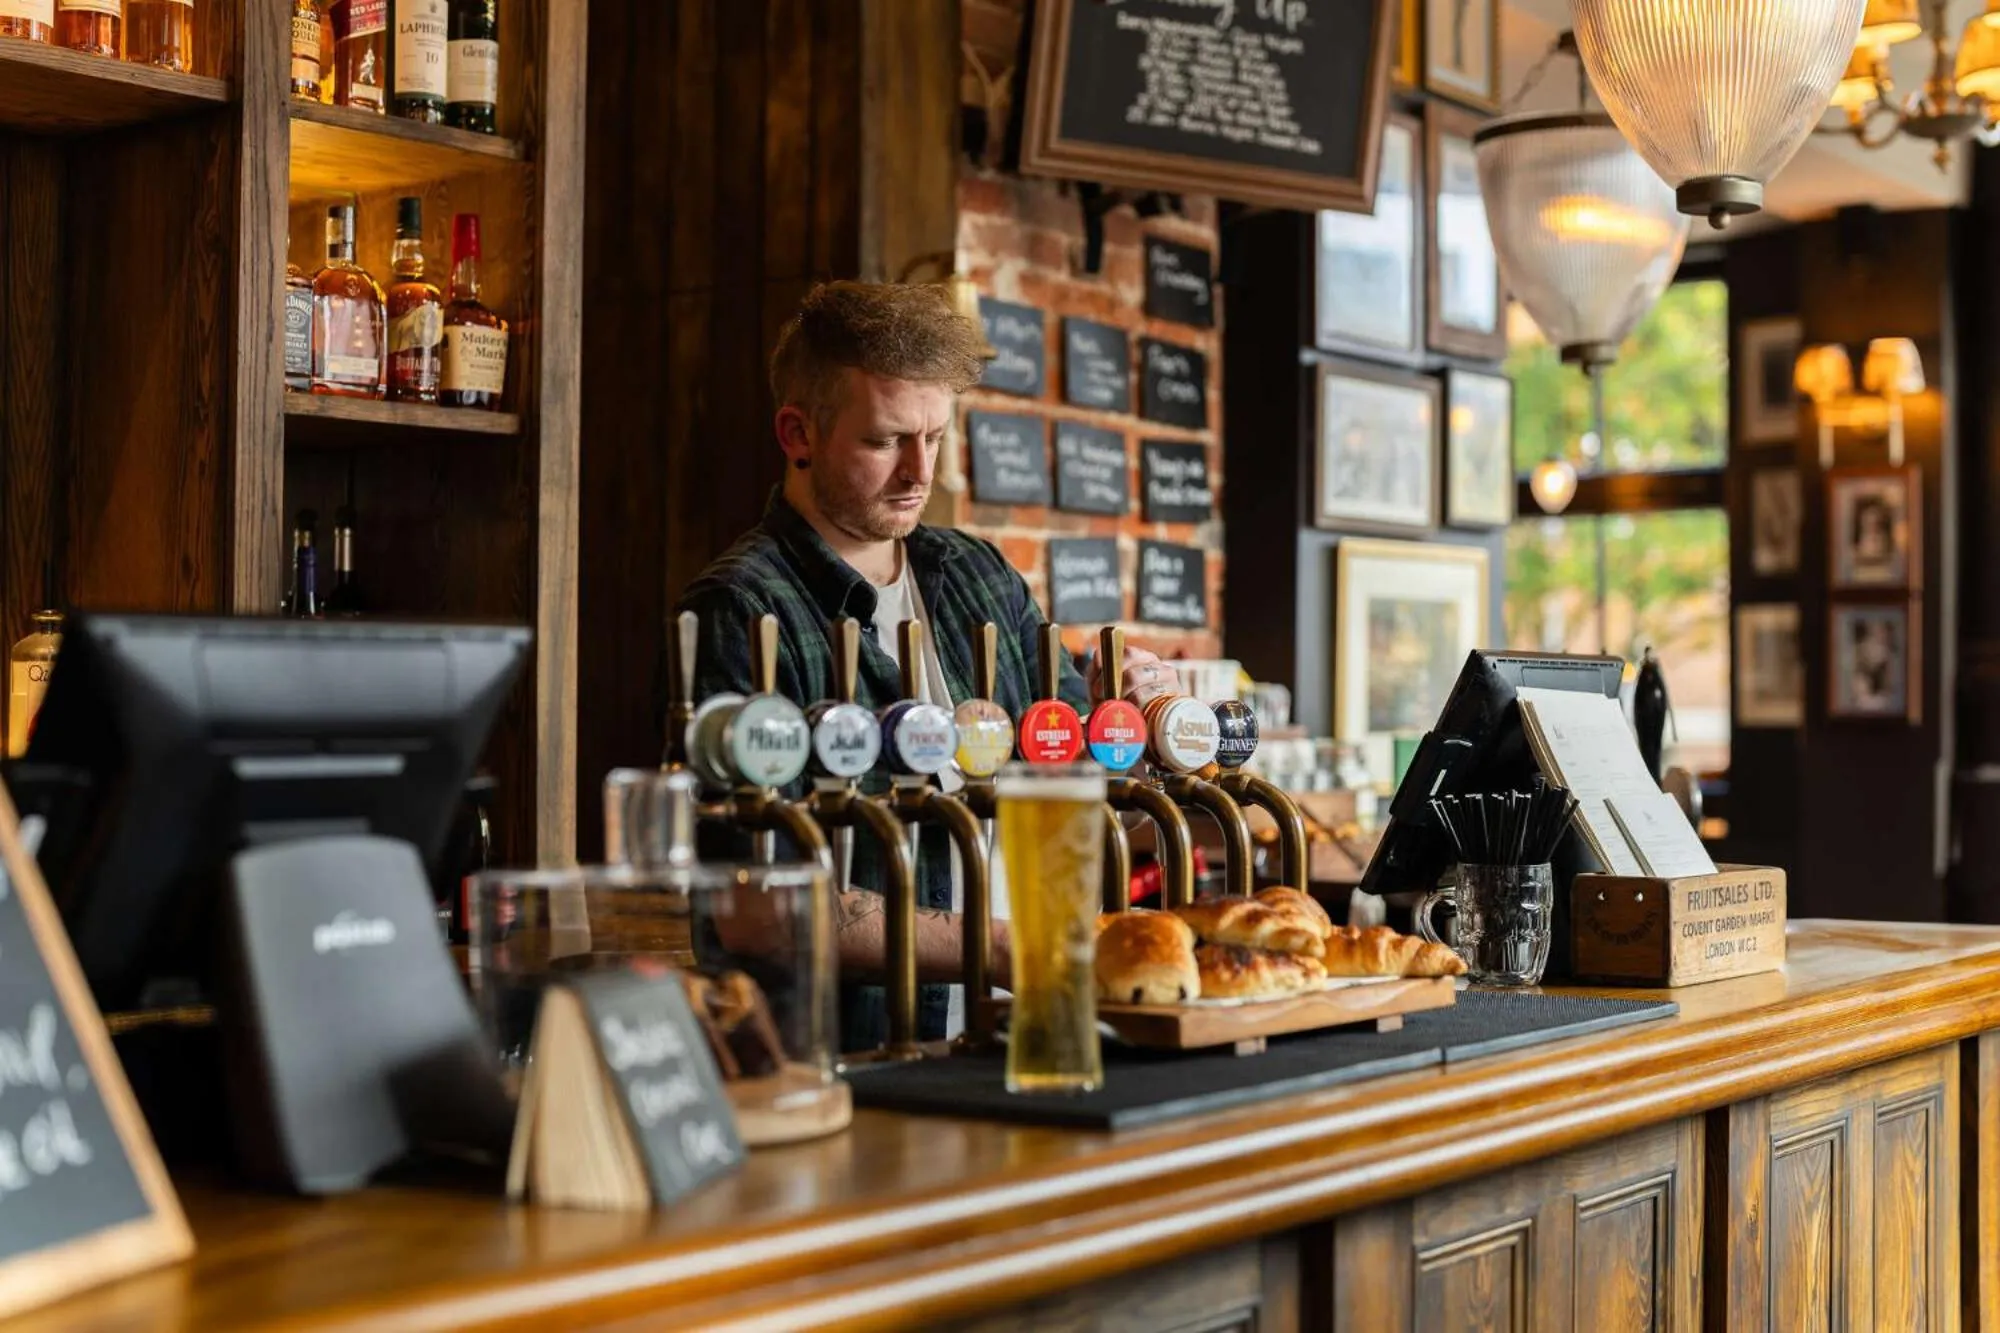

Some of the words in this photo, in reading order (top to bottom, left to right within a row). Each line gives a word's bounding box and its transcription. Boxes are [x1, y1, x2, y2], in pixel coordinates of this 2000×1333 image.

[425, 51, 439, 64] 10
[1036, 729, 1071, 742] ESTRELLA
[1104, 727, 1135, 739] ESTRELLA
[1172, 716, 1214, 737] ASPALL
[1687, 883, 1749, 912] FRUITSALES
[1753, 880, 1776, 901] LTD.
[1682, 919, 1713, 938] COVENT
[1715, 914, 1747, 933] GARDEN
[1705, 940, 1736, 960] LONDON
